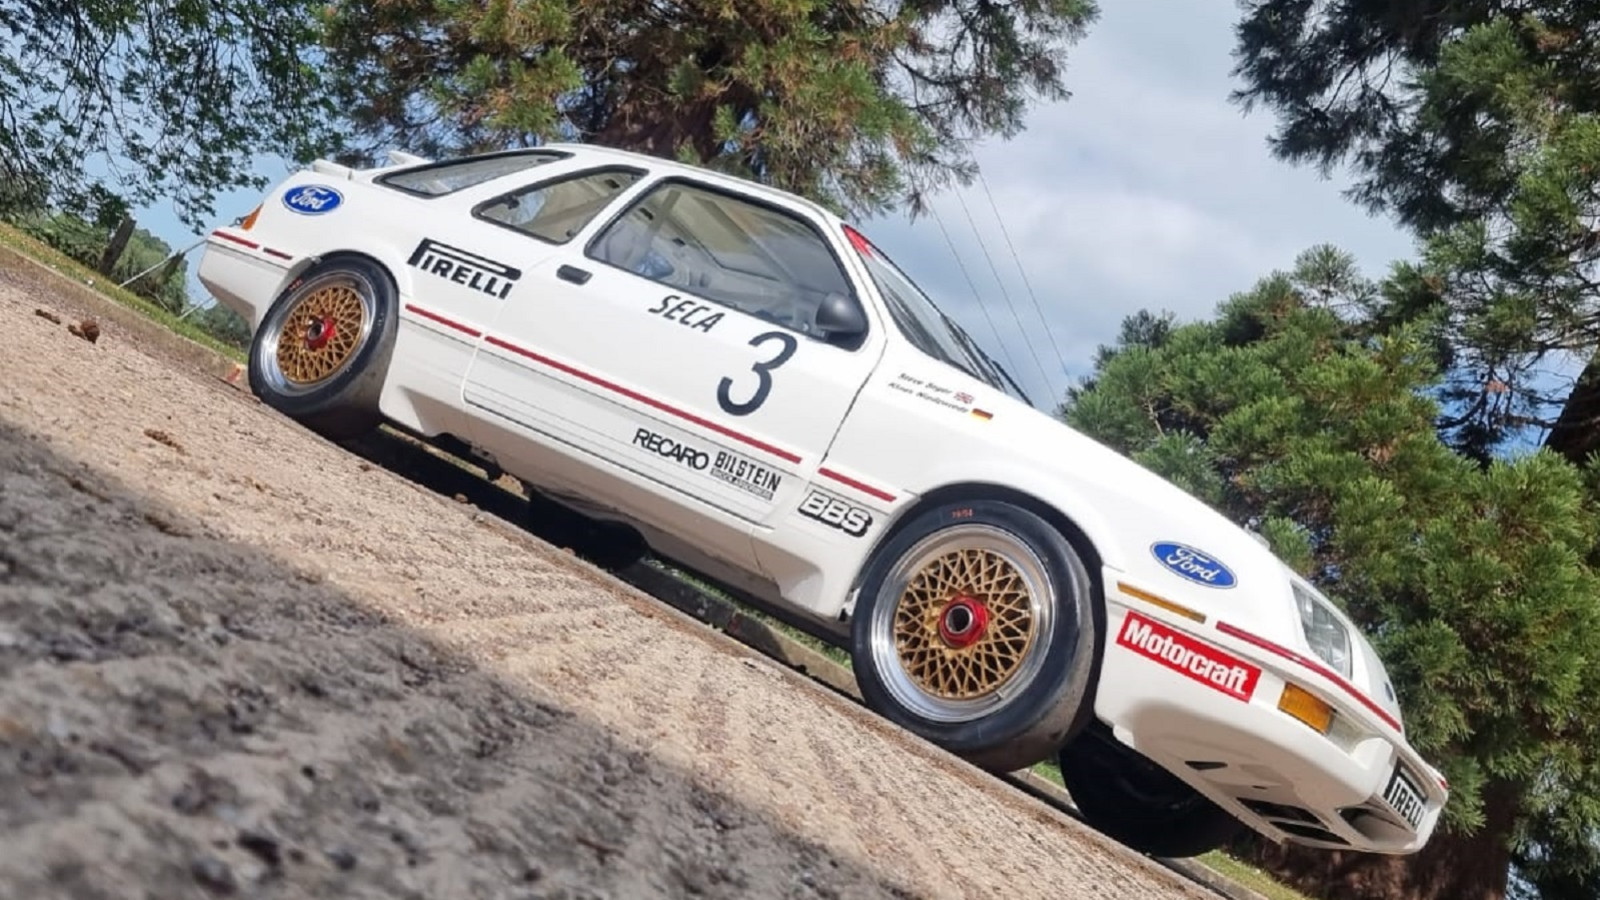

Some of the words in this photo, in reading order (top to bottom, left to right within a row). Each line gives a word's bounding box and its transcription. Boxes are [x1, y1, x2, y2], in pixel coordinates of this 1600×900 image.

[291, 187, 333, 209] Ford
[407, 237, 522, 300] PIRELLI
[648, 295, 725, 333] SECA
[717, 331, 798, 416] 3
[633, 428, 709, 471] RECARO
[714, 451, 781, 492] BILSTEIN
[798, 489, 872, 537] BBS
[1166, 548, 1220, 581] Ford
[1123, 618, 1248, 695] Motorcraft
